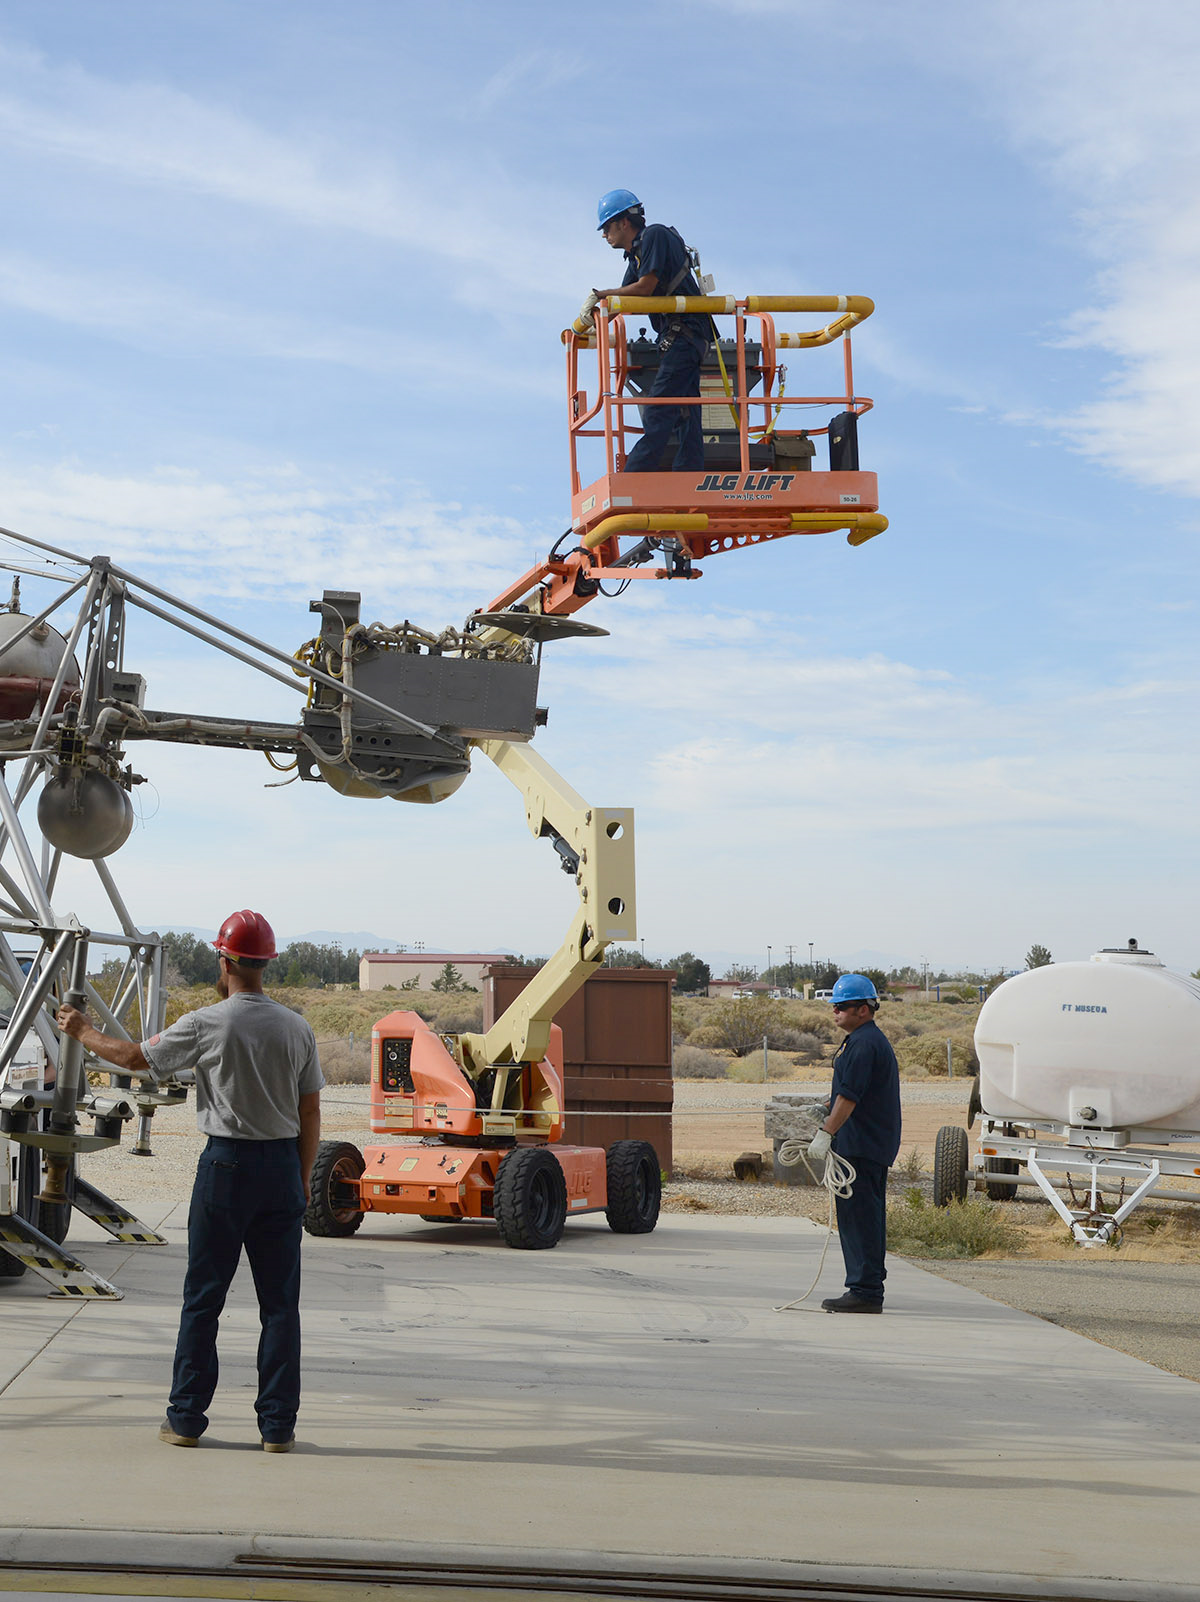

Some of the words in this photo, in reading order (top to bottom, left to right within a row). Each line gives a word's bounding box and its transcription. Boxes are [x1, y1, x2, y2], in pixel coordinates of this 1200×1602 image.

[696, 474, 740, 491] JLG
[743, 474, 795, 491] LIFT
[569, 1170, 593, 1195] JLG
